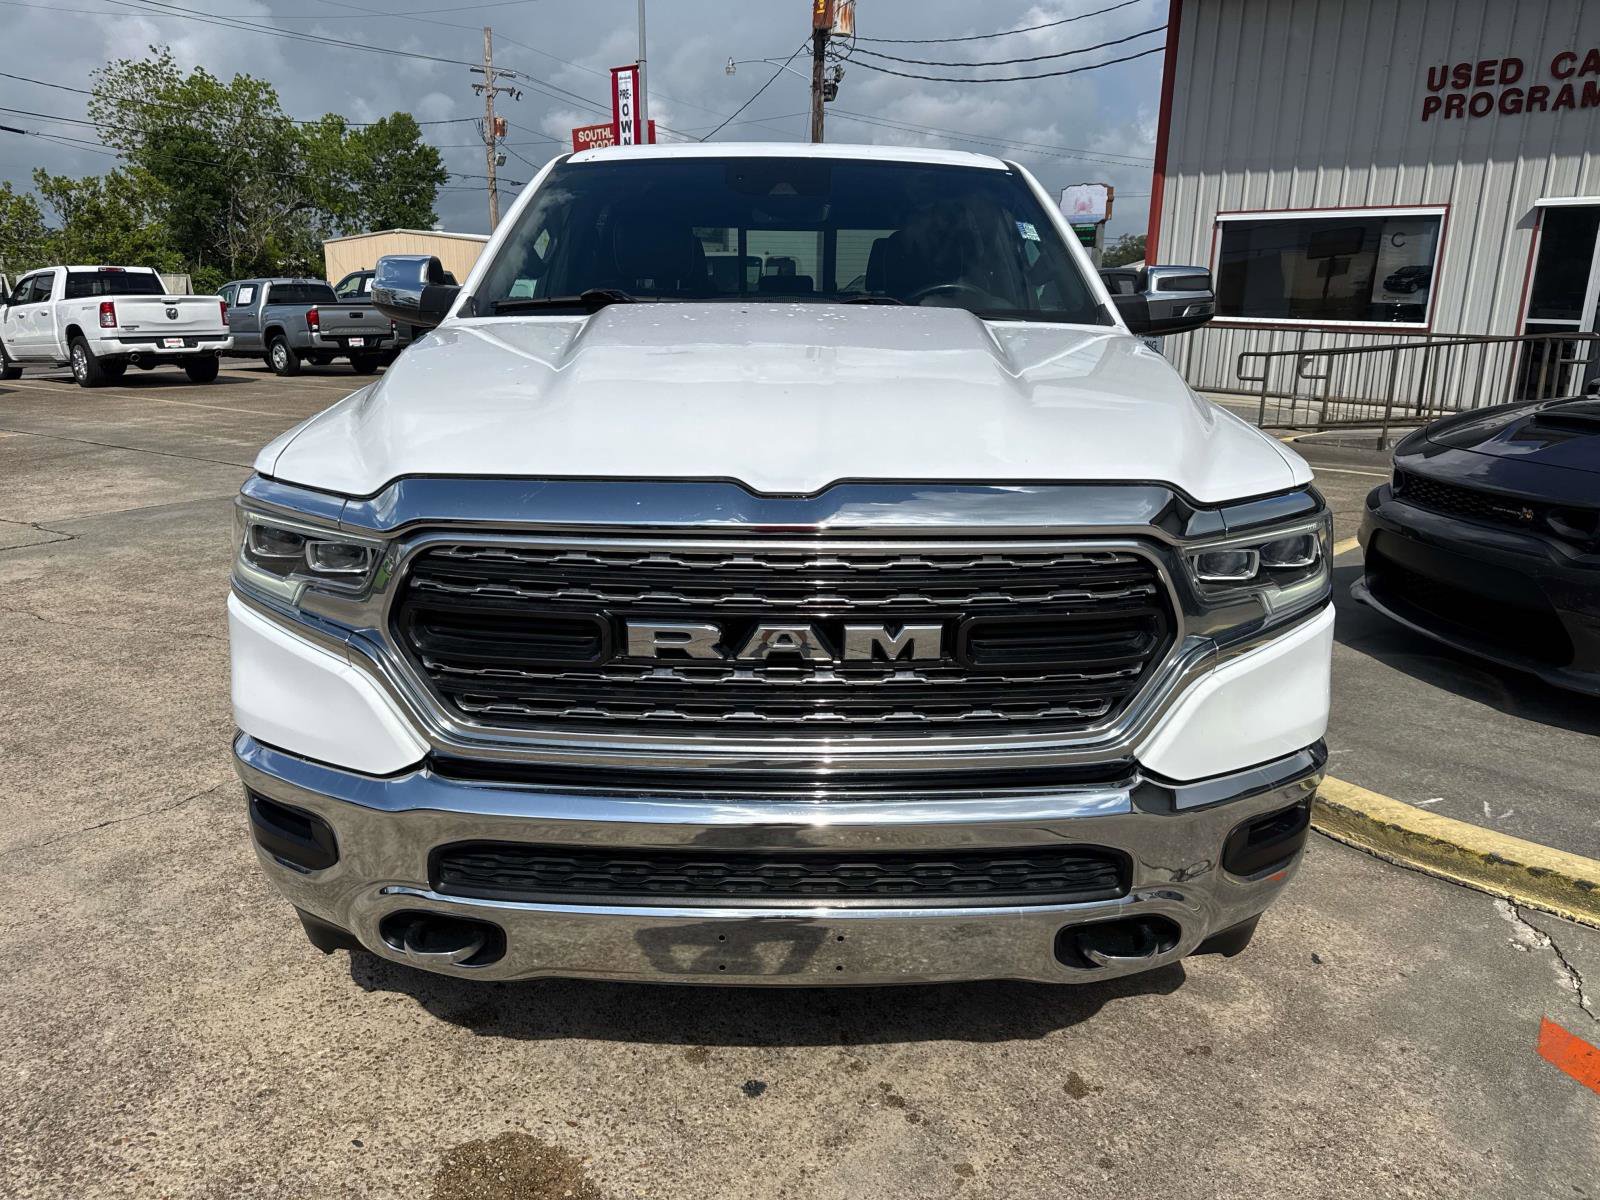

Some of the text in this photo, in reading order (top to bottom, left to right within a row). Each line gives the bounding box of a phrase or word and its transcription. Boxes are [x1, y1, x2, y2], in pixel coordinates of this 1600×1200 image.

[1427, 48, 1600, 92] USED CA
[1421, 81, 1600, 121] PROGRAM
[626, 622, 943, 660] RAM
